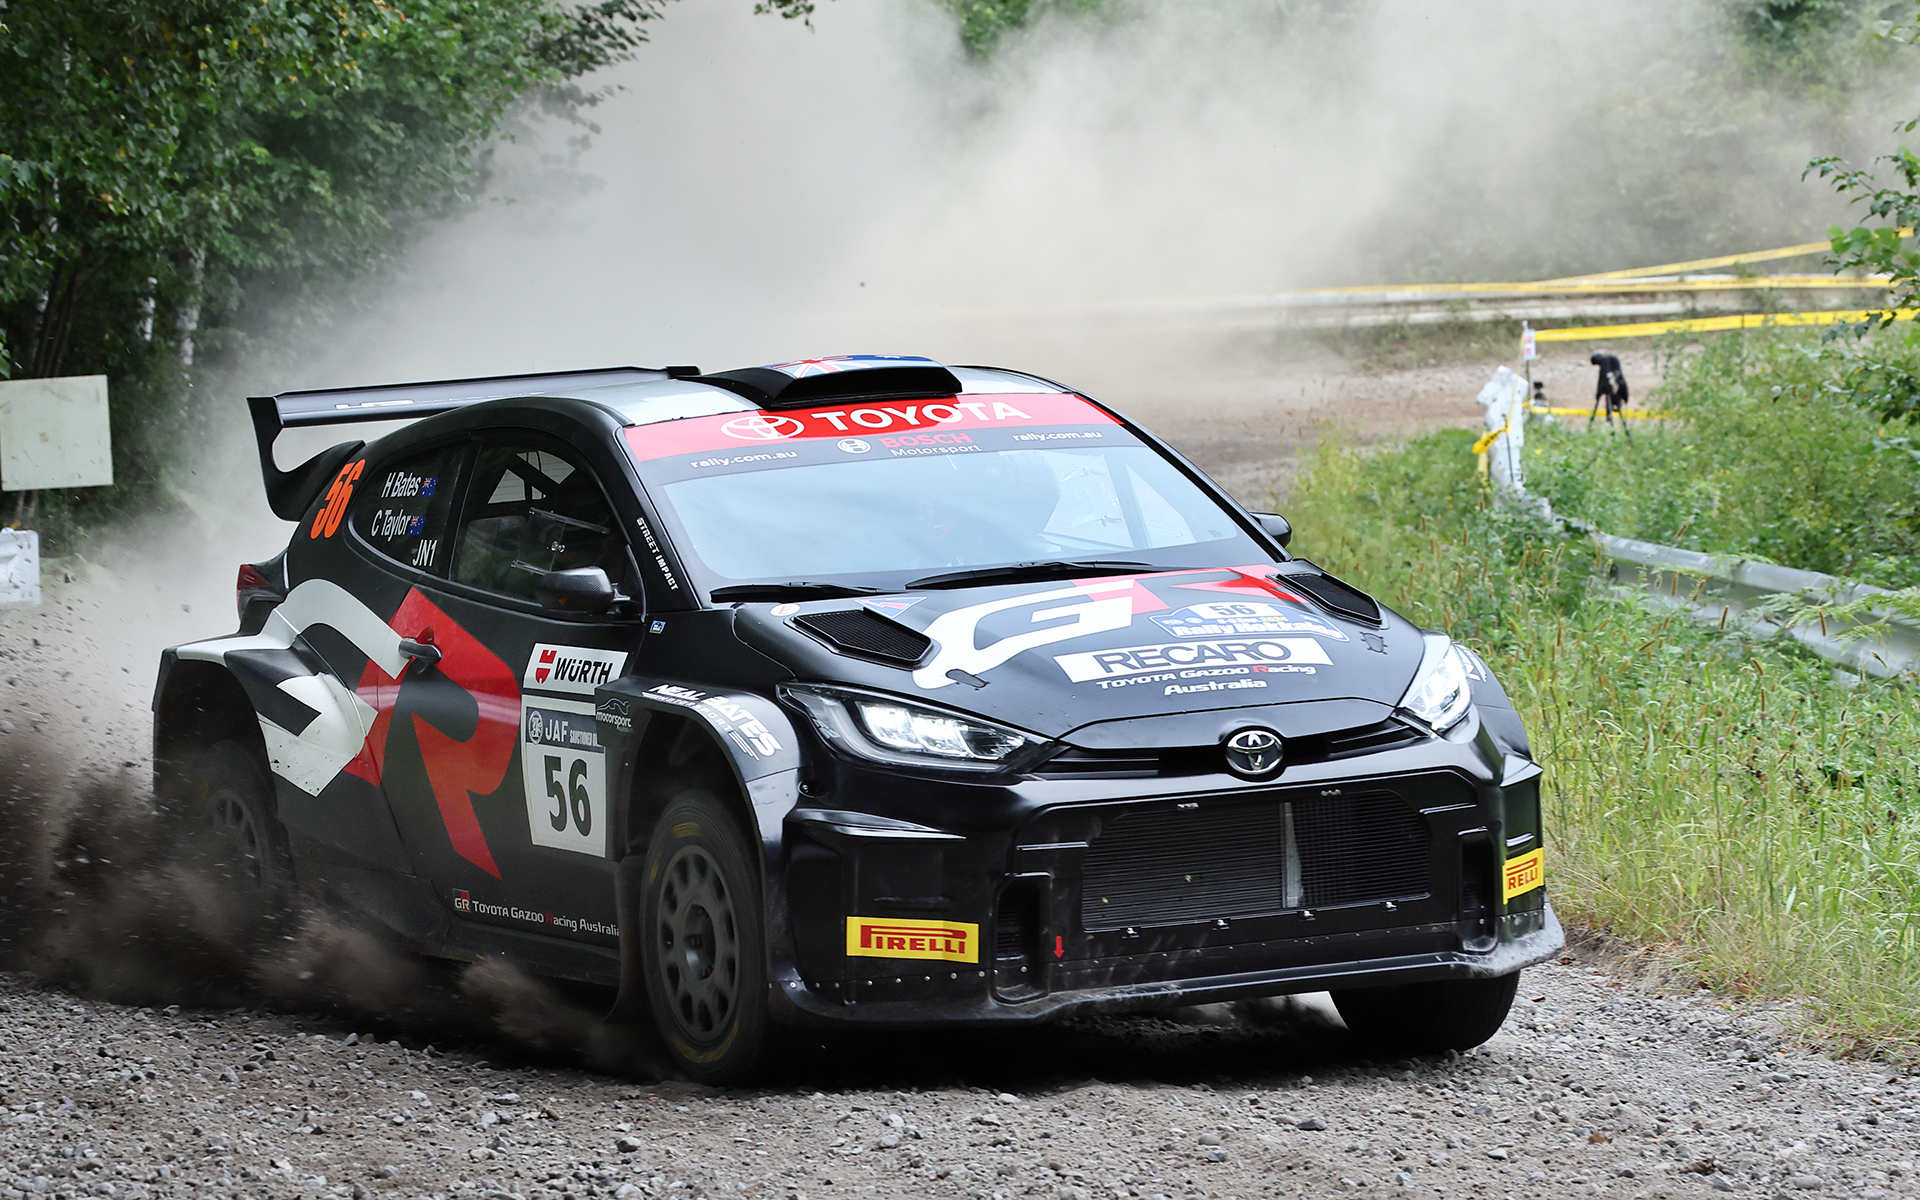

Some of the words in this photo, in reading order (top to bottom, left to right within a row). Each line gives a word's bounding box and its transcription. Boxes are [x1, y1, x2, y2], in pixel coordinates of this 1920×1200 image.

[811, 401, 1032, 432] TOYOTA
[878, 433, 974, 448] BOSCH
[1012, 430, 1103, 443] rally.com.au
[690, 450, 798, 469] rally.com.au
[890, 444, 983, 458] Motorsport
[381, 472, 396, 498] H
[391, 471, 421, 497] Bates
[310, 459, 366, 539] 56
[371, 509, 382, 537] C
[381, 509, 411, 541] Taylor
[412, 539, 437, 567] JN1
[637, 517, 660, 553] STREET
[655, 554, 679, 591] IMPACT
[1208, 604, 1258, 616] 56
[1172, 621, 1236, 637] Rally
[1238, 619, 1344, 640] Hokkaido
[554, 657, 613, 685] WÜRTH
[1092, 641, 1292, 674] RECARO
[1095, 672, 1178, 690] TOYOTA
[1179, 666, 1250, 679] GAZOO
[1251, 665, 1317, 676] Racing
[1163, 678, 1268, 697] Australia
[545, 719, 569, 743] JAF
[648, 684, 707, 701] NEAL
[701, 695, 784, 757] BATES
[543, 754, 592, 837] 56
[454, 897, 471, 912] GR
[471, 900, 510, 918] TOYOTA
[510, 906, 545, 924] GAZOO
[545, 912, 578, 933] Racing
[860, 924, 967, 955] PIRELLI
